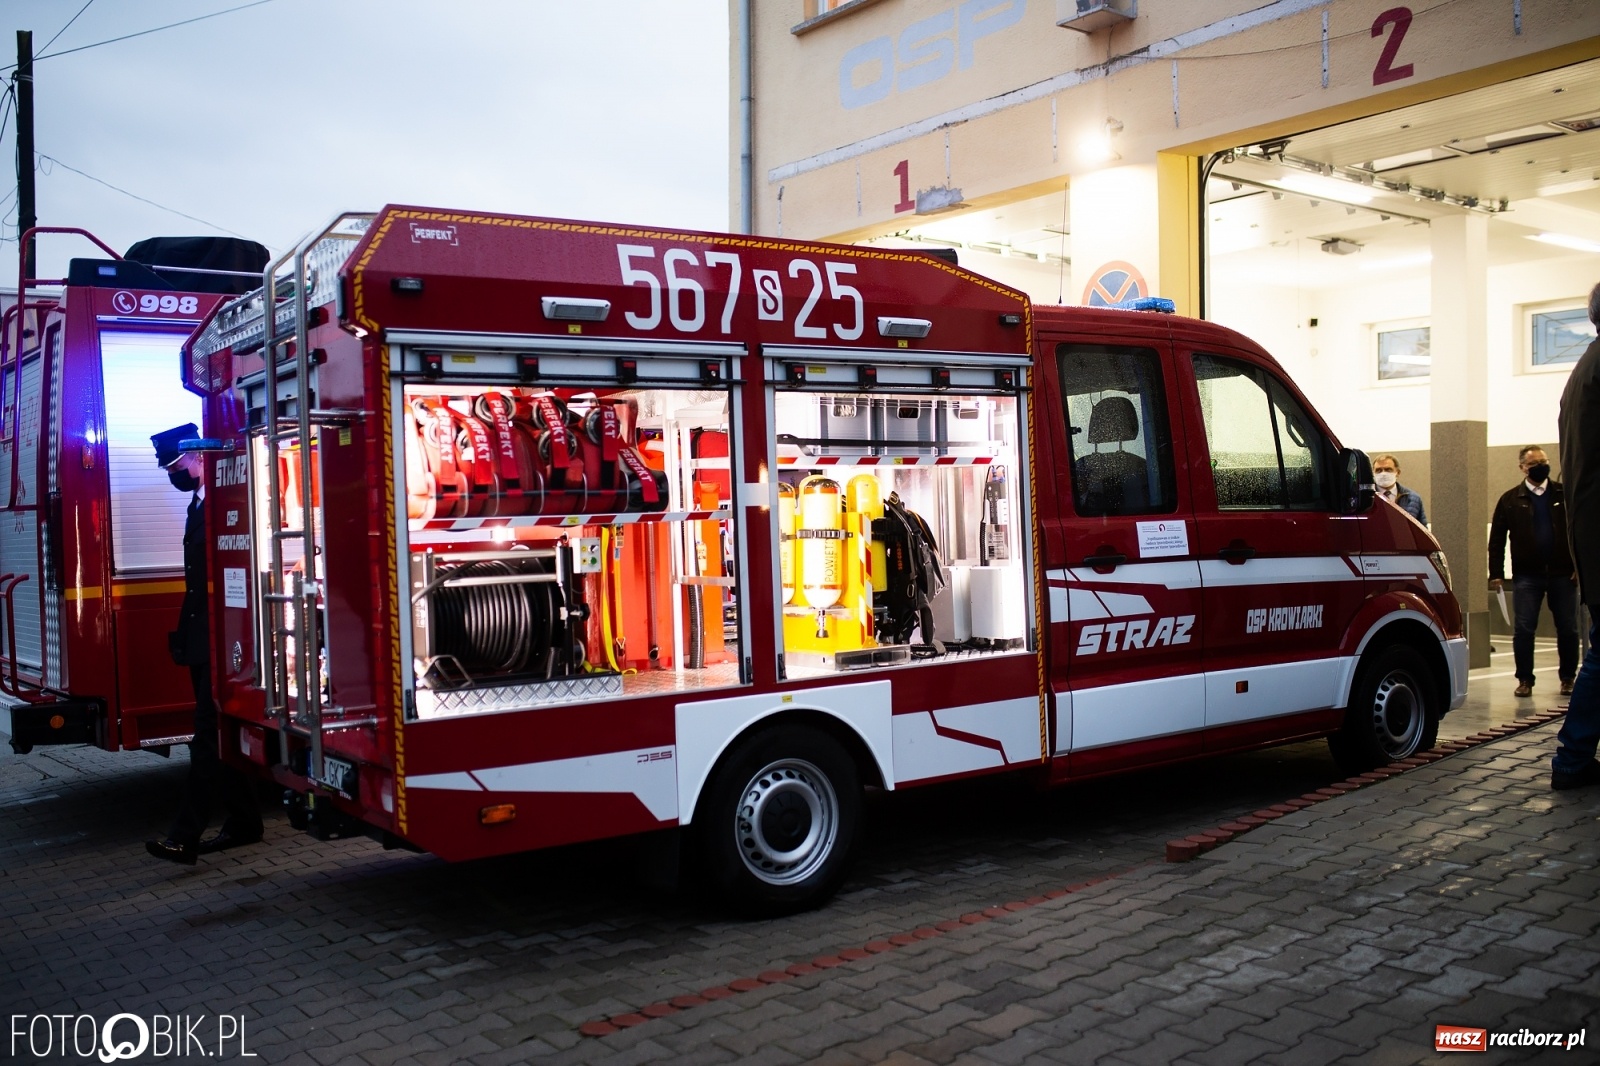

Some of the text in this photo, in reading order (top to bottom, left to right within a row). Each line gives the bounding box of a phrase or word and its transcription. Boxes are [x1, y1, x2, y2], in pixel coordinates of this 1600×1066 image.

[839, 0, 1028, 110] OSP
[1371, 6, 1414, 86] 2
[893, 159, 915, 214] 1
[414, 228, 452, 240] PERFEKT
[139, 294, 198, 314] 998
[617, 243, 864, 341] 567 S 25
[490, 399, 514, 459] PERFEKT
[540, 397, 566, 445] PERFEKT
[620, 449, 653, 483] PERFEKT
[1246, 604, 1323, 633] OSP KROWIARKI
